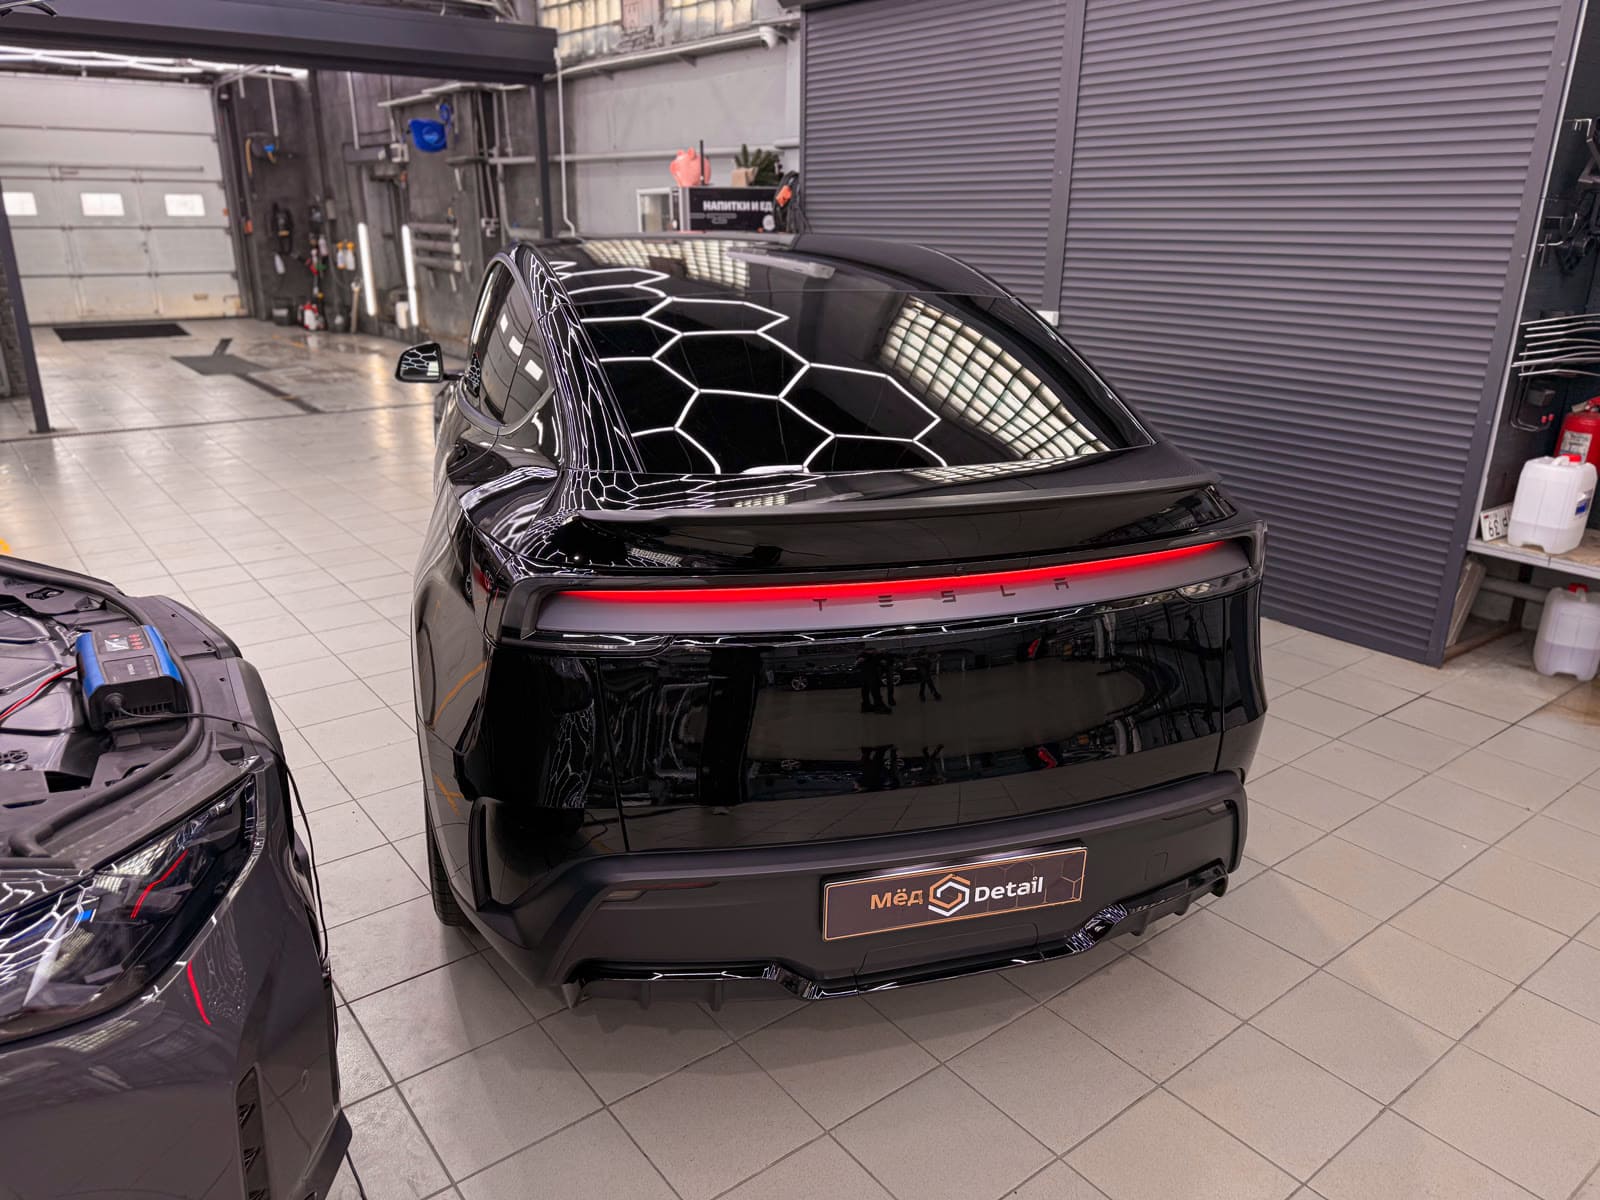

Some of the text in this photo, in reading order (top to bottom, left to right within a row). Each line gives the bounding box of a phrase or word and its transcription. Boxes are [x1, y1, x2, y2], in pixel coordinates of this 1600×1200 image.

[703, 200, 774, 213] НАПИТКИ И ЕД
[812, 577, 1070, 612] TESLA
[870, 876, 1044, 910] Мёд Detail
